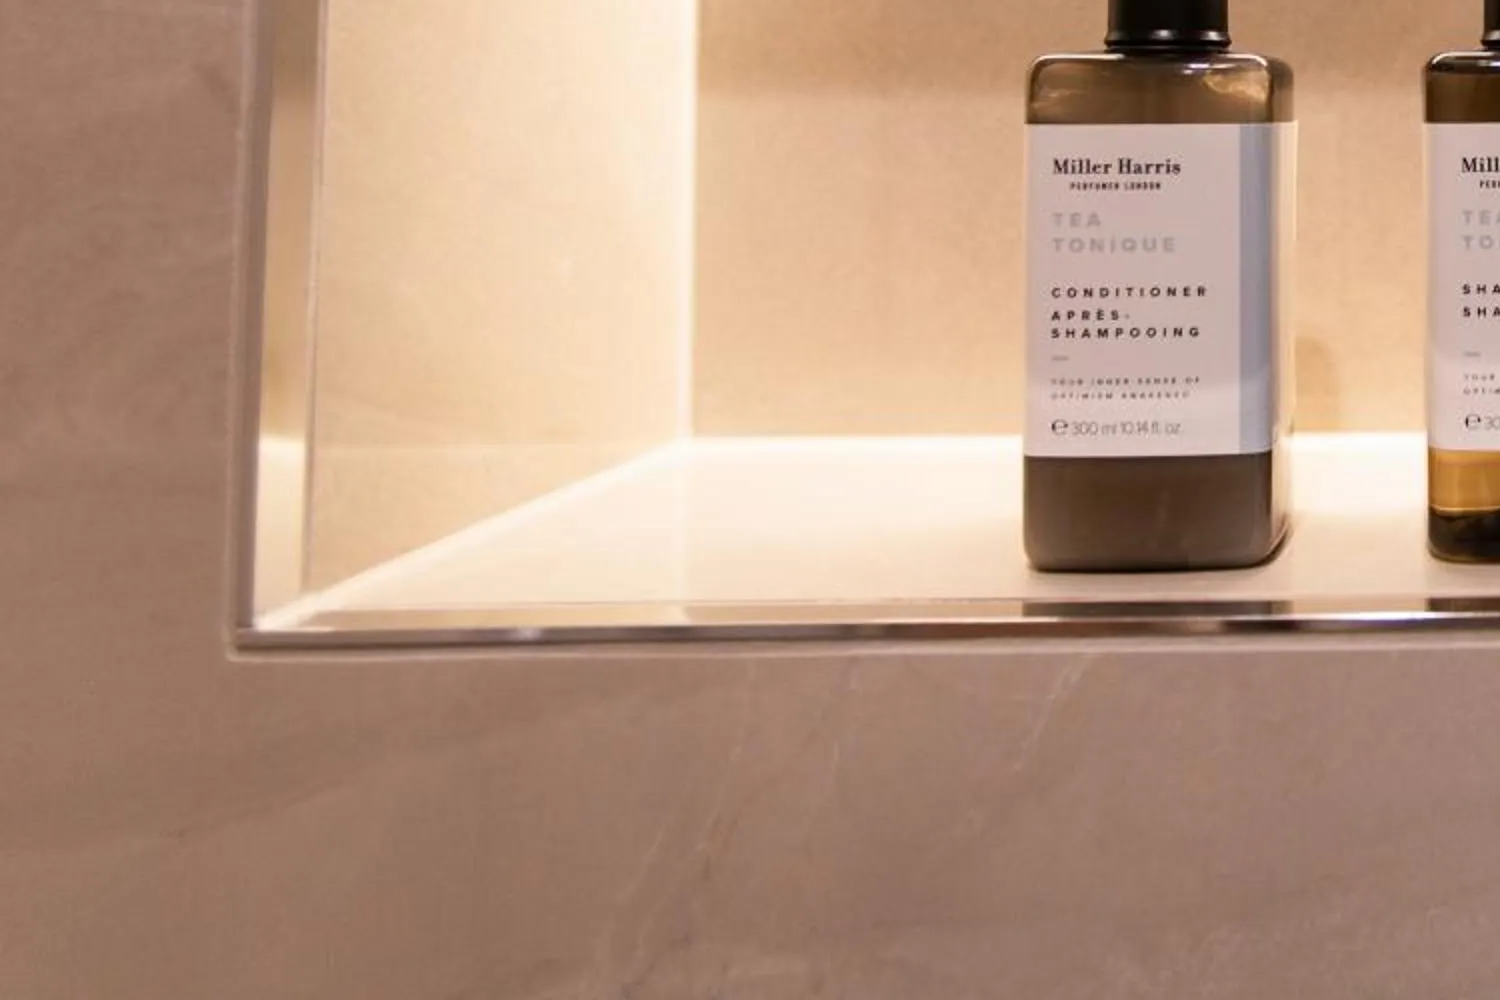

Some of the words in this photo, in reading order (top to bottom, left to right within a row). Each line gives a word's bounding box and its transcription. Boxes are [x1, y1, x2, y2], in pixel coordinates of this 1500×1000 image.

[1053, 158, 1112, 175] Miller
[1118, 158, 1181, 175] Harris
[1052, 212, 1102, 228] TEA
[1052, 237, 1176, 254] TONIQUE
[1051, 286, 1207, 299] CONDITIONER
[1051, 327, 1200, 339] SHAMPOOING
[1072, 420, 1099, 435] 300
[1101, 421, 1117, 434] ml
